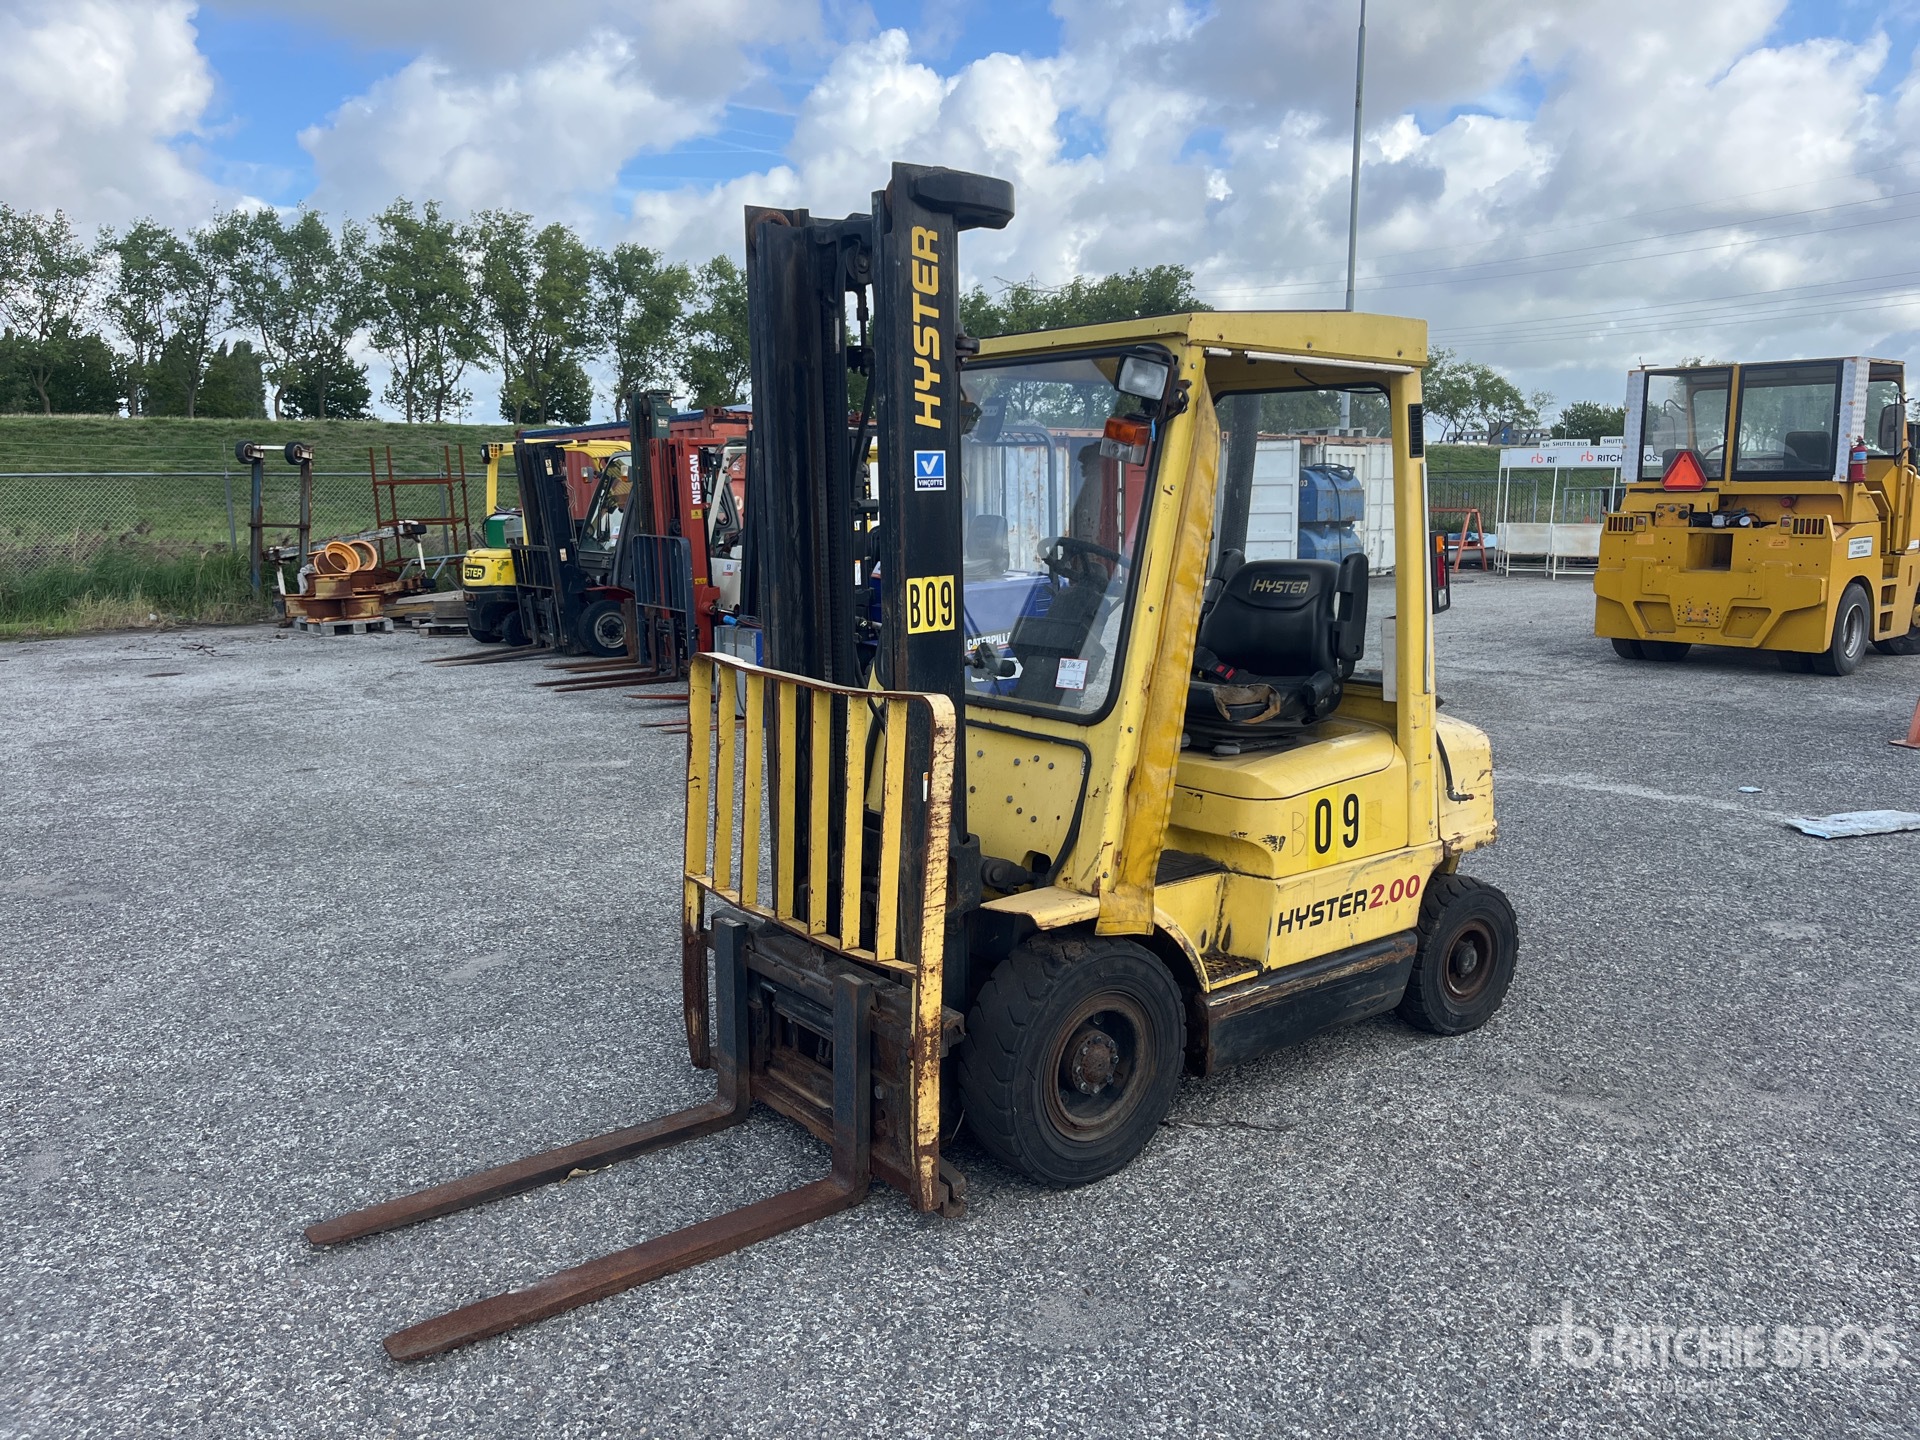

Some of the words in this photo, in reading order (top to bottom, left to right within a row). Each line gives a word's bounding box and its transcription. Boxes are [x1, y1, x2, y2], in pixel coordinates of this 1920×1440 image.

[911, 225, 941, 429] HYSTER
[1531, 452, 1544, 464] rb
[1581, 450, 1594, 462] rb
[689, 454, 702, 505] NISSAN
[918, 478, 943, 488] VINÇOTTE
[1253, 579, 1309, 594] HYSTER
[909, 580, 952, 629] B09
[1276, 889, 1368, 937] HYSTER
[1369, 874, 1421, 910] 2.00
